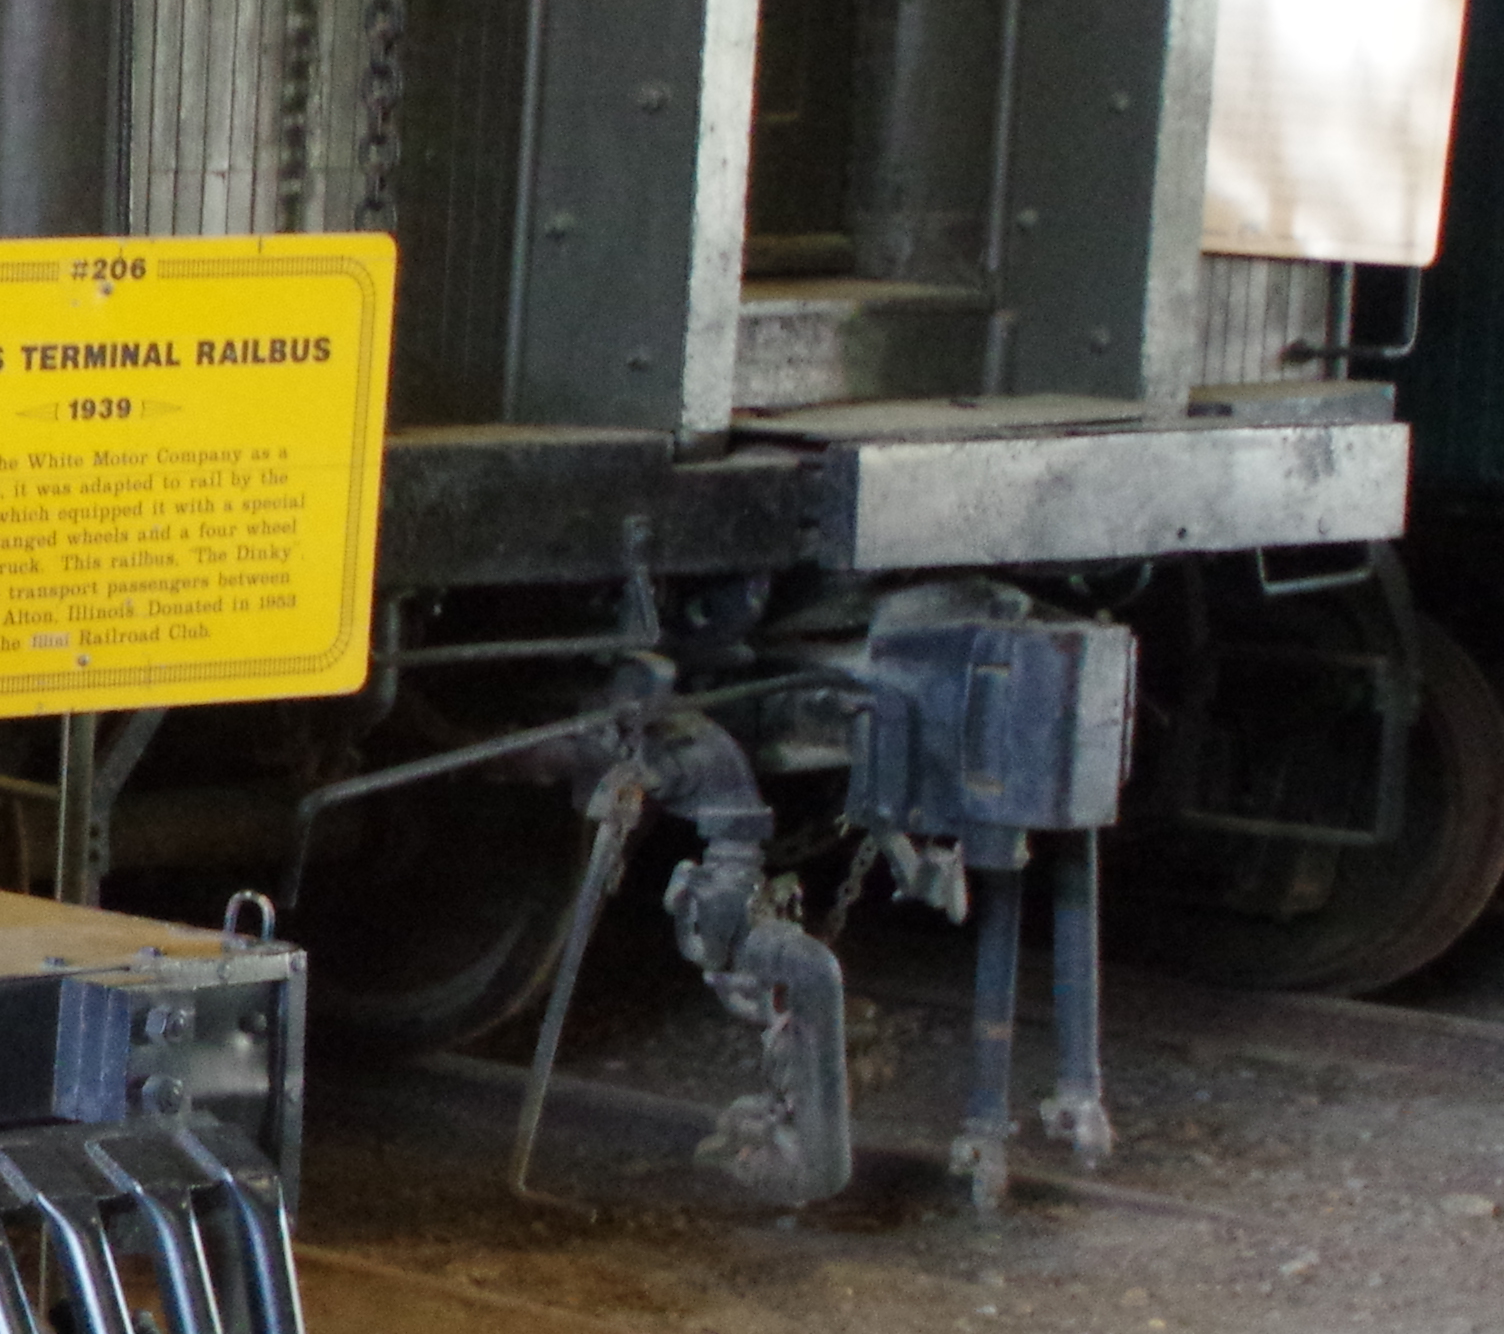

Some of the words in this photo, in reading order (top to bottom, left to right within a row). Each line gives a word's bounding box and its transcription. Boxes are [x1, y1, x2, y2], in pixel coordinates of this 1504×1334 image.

[71, 257, 147, 281] #206
[20, 341, 181, 372] TERMINAL
[195, 336, 333, 366] RAILBUS
[67, 397, 133, 421] 1939
[28, 452, 83, 470] White
[93, 449, 148, 467] Motor
[157, 447, 242, 466] Company
[251, 448, 270, 461] as
[279, 448, 288, 460] a
[14, 481, 27, 498] it
[37, 481, 71, 497] was
[79, 475, 152, 498] adapted
[163, 474, 180, 490] to
[190, 472, 222, 490] rail
[231, 470, 250, 490] by
[260, 468, 288, 486] the
[58, 501, 142, 524] equipped
[152, 498, 165, 516] it
[175, 496, 215, 515] with
[223, 499, 233, 512] a
[242, 492, 305, 515] special
[67, 526, 128, 545] wheels
[137, 524, 170, 543] and
[179, 527, 190, 540] a
[199, 521, 237, 539] four
[247, 517, 297, 536] wheel
[62, 554, 101, 572] This
[9, 580, 98, 601] transport
[107, 574, 210, 598] passengers
[218, 571, 291, 589] between
[148, 597, 223, 618] Donated
[232, 596, 250, 612] in
[78, 625, 160, 648] Railroad
